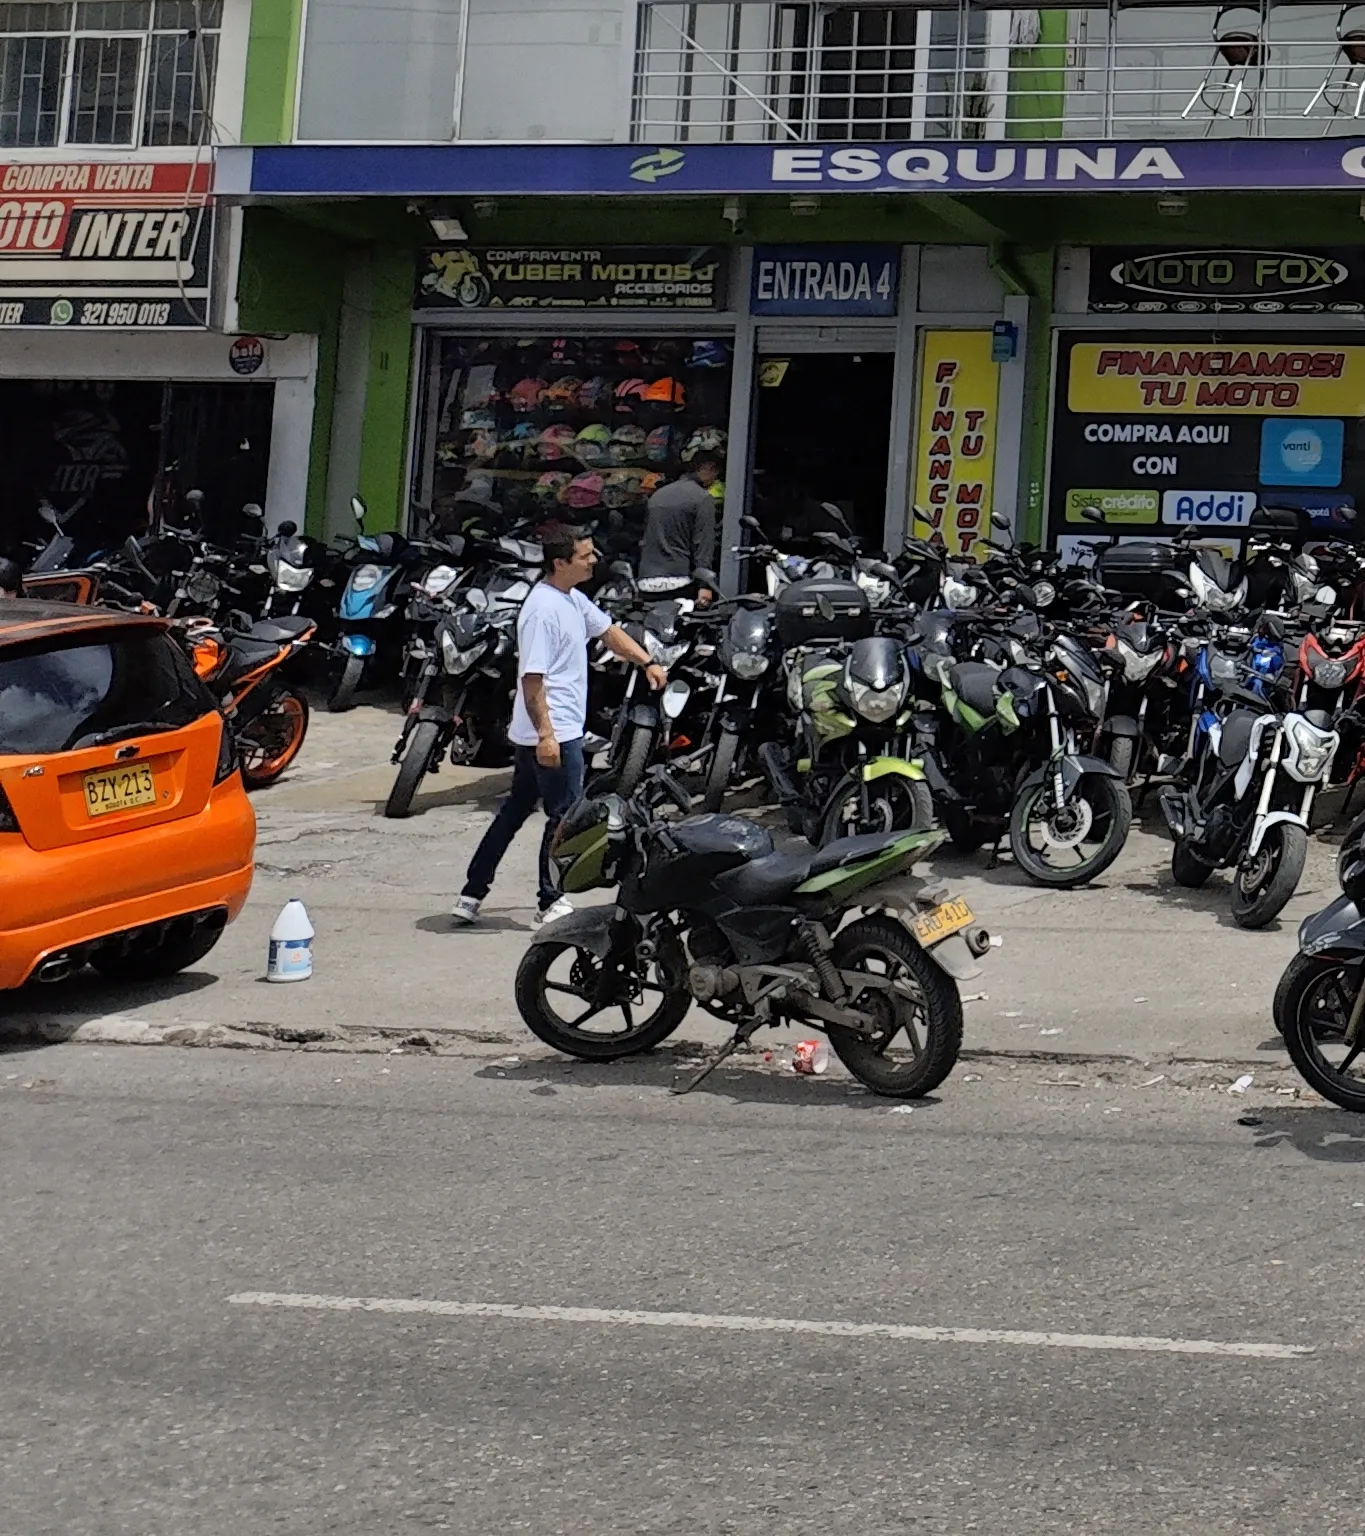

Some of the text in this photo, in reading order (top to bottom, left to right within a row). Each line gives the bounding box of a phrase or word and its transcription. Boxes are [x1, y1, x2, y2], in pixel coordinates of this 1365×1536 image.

[2, 164, 155, 191] COMPRA VENTA
[770, 147, 1185, 184] ESQUINA
[69, 211, 191, 258] INTER
[486, 250, 602, 262] COMPRAVENTA
[486, 264, 581, 281] YUBER
[592, 264, 691, 281] MOTOS
[757, 261, 891, 301] ENTRADA 4
[1124, 258, 1336, 287] MOTO FOX
[614, 283, 713, 295] ACCESORIOS
[81, 303, 105, 325] 321
[107, 303, 136, 325] 950
[137, 303, 171, 325] 0113
[1096, 350, 1346, 378] FINANCIAMOS!
[1140, 381, 1301, 408] TU MOTO
[960, 410, 985, 457] TU
[1083, 424, 1230, 444] COMPRA AQUI
[1283, 441, 1311, 452] vanti
[1132, 456, 1178, 475] CON
[1176, 494, 1245, 522] Addi
